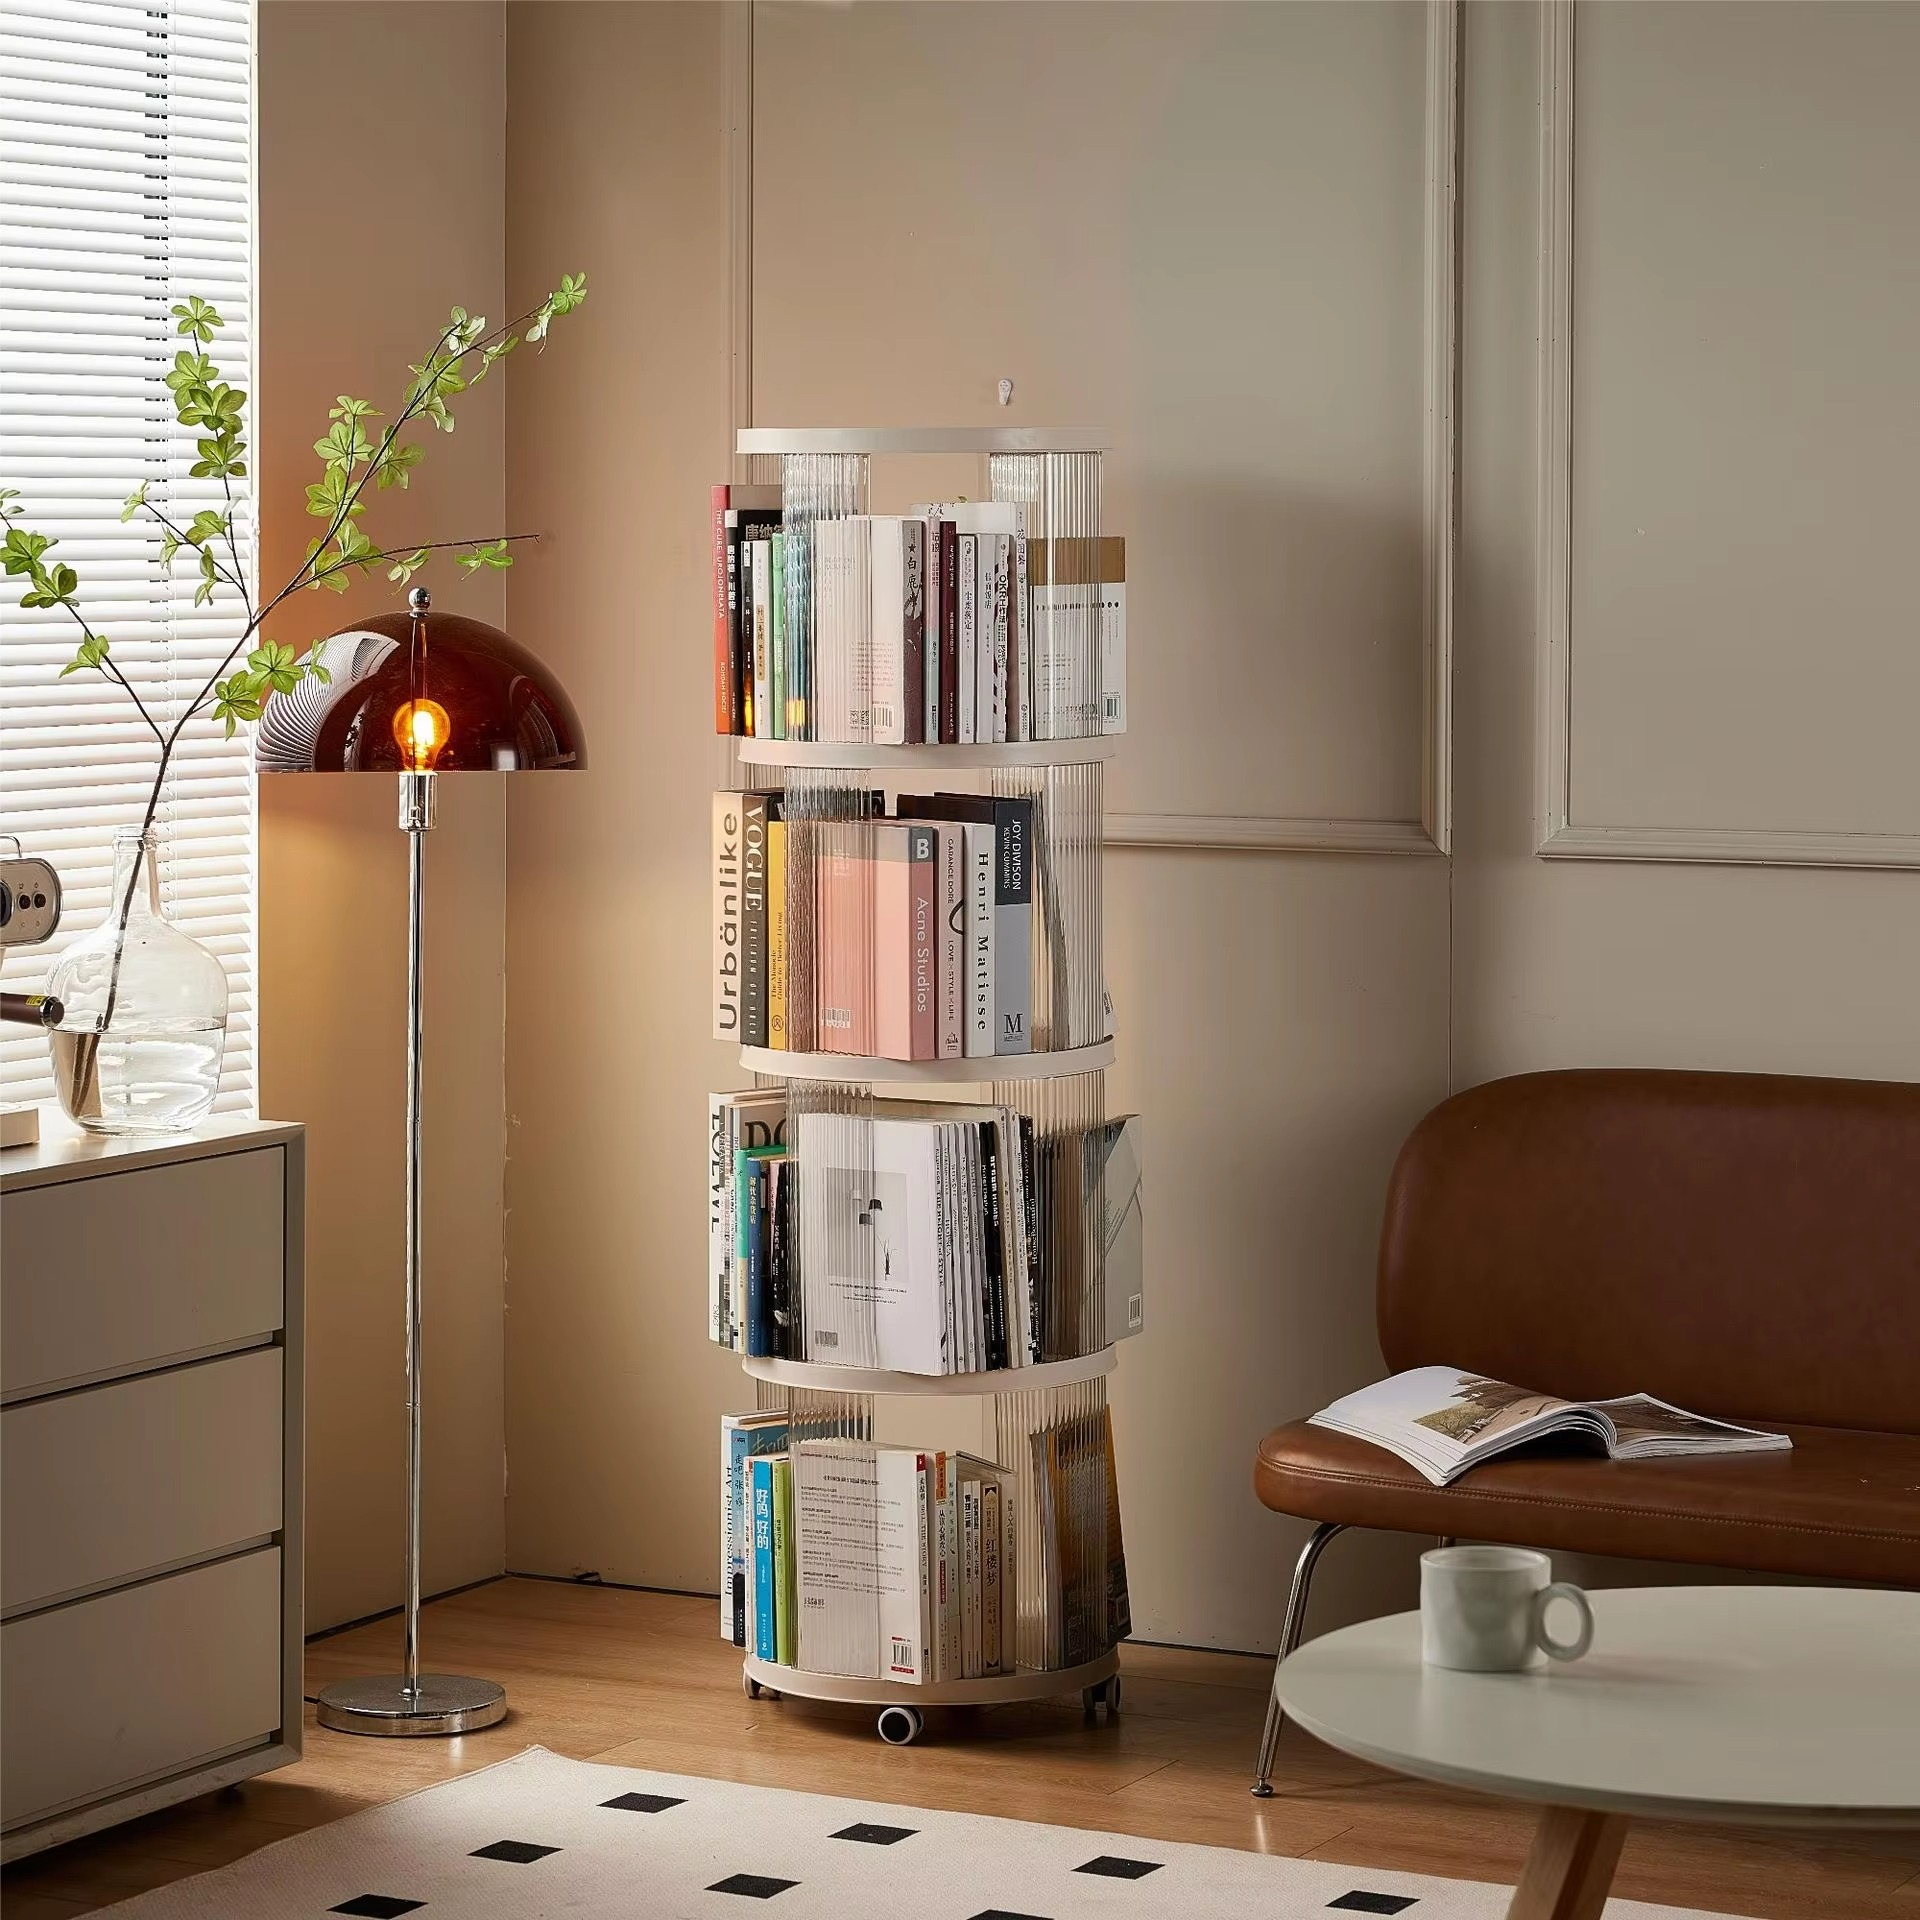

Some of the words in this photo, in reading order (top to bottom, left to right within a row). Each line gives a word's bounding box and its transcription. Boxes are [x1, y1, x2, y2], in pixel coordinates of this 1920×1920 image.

[745, 804, 763, 911] VOGUE
[916, 838, 929, 859] B
[1012, 819, 1022, 840] JOY
[917, 896, 929, 942] Acne
[978, 852, 989, 922] Henri
[719, 812, 738, 1030] Urbänlike
[917, 946, 929, 1013] Studios
[978, 935, 989, 1031] Matisse
[1004, 1013, 1023, 1034] M
[724, 1494, 733, 1596] Impressionist
[756, 1488, 769, 1550] 好吗好的
[986, 1538, 997, 1587] 红楼梦
